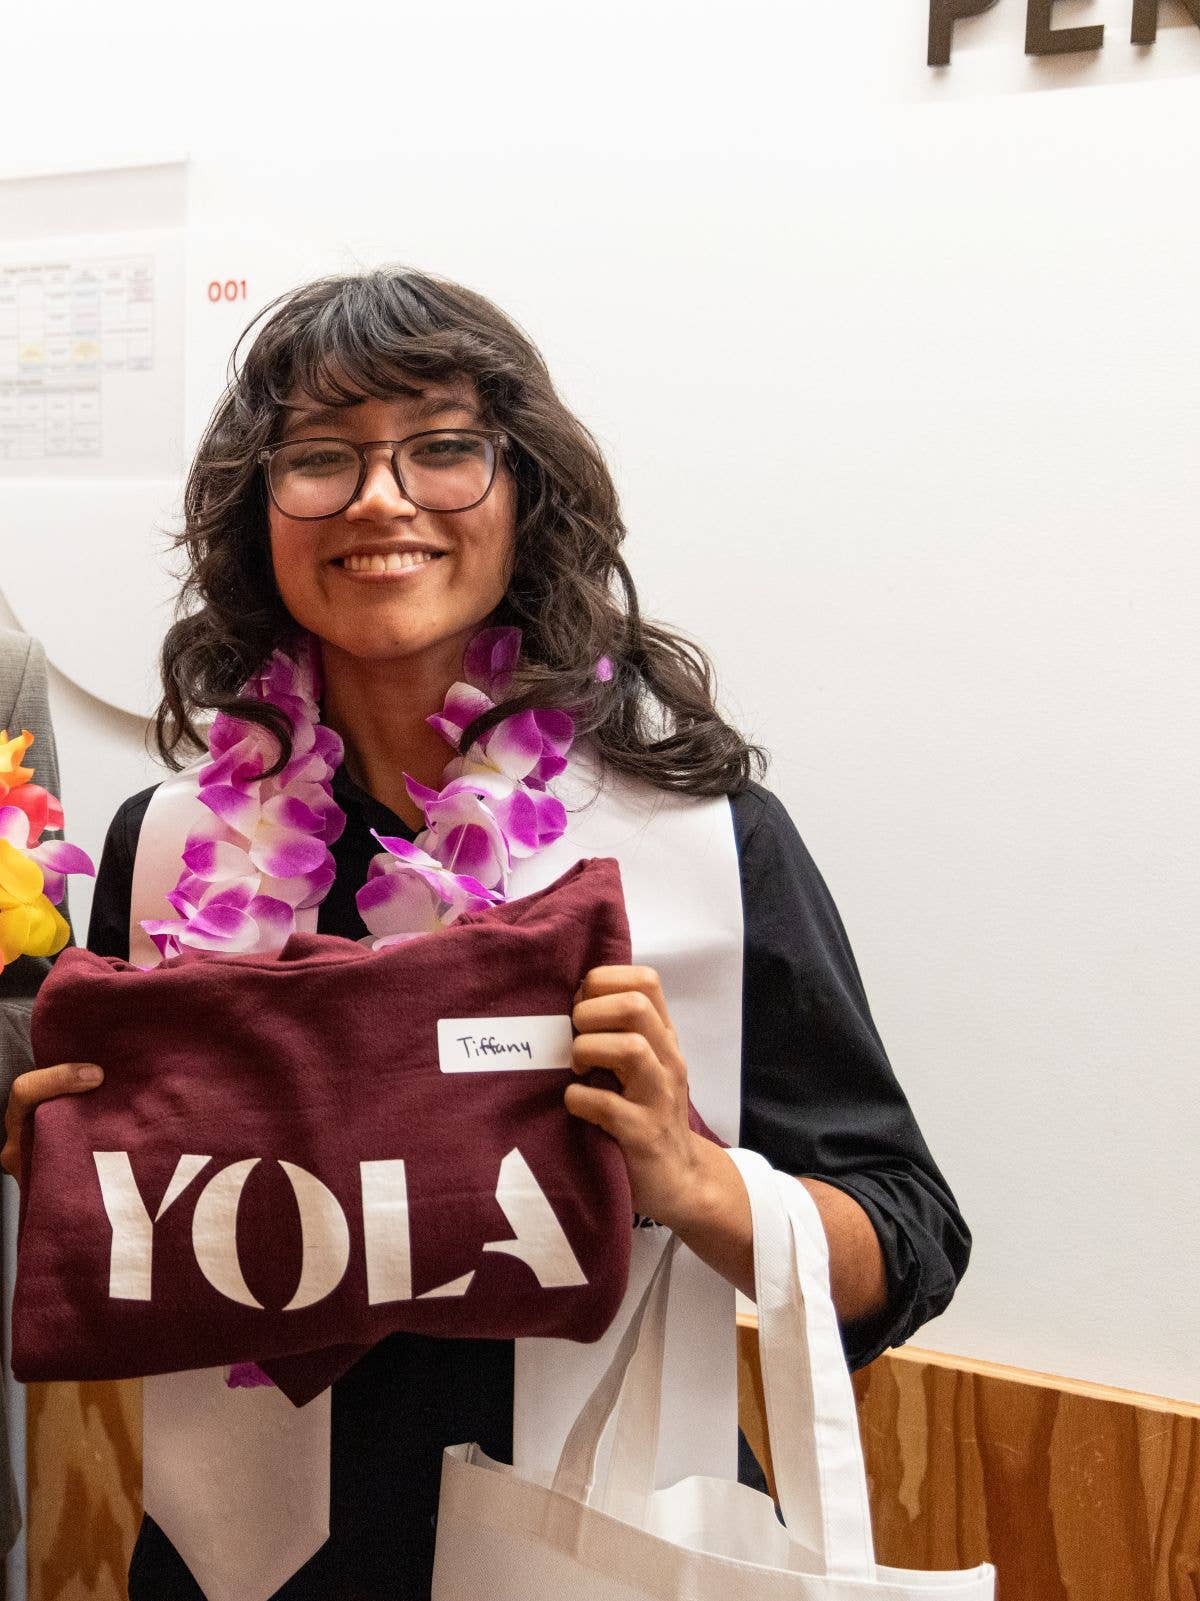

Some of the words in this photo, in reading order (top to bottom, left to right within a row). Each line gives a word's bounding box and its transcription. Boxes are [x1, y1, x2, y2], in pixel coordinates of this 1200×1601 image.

[208, 280, 246, 302] 001
[456, 1036, 532, 1060] Tiffany
[92, 1147, 589, 1312] YOLA
